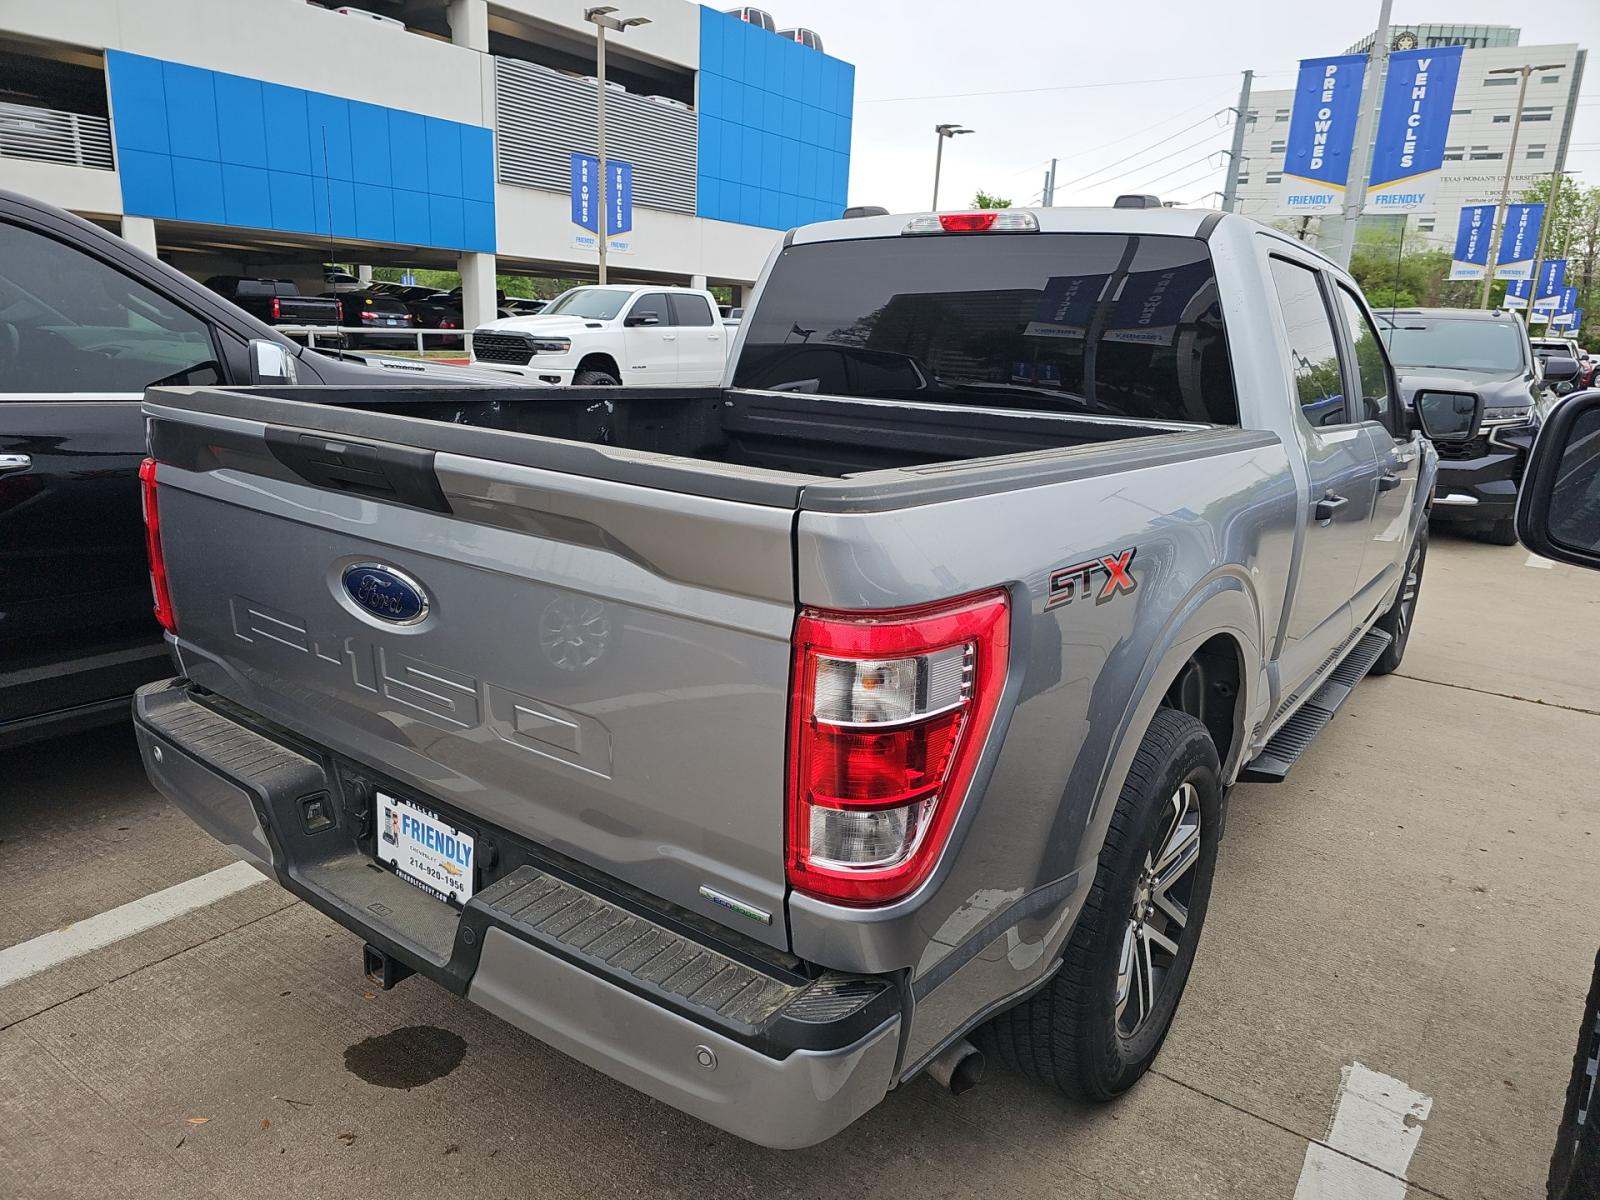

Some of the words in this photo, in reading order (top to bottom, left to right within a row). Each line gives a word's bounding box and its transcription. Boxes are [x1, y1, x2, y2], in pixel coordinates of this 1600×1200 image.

[1321, 65, 1338, 103] PRE
[1400, 58, 1432, 168] VEHICLES
[1310, 107, 1332, 170] OWNED
[581, 185, 589, 222] OWNED
[1288, 194, 1334, 205] FRIENDLY
[1374, 193, 1425, 205] FRIENDLY
[1471, 208, 1482, 228] NEW
[1467, 228, 1479, 260] CHEVY
[1512, 208, 1530, 259] VEHICLES
[358, 575, 404, 613] Ford
[1043, 546, 1137, 613] STX
[230, 593, 613, 781] F-150
[405, 800, 438, 820] DALLAS
[402, 813, 472, 868] FRIENDLY
[409, 856, 465, 892] 214-920-1956
